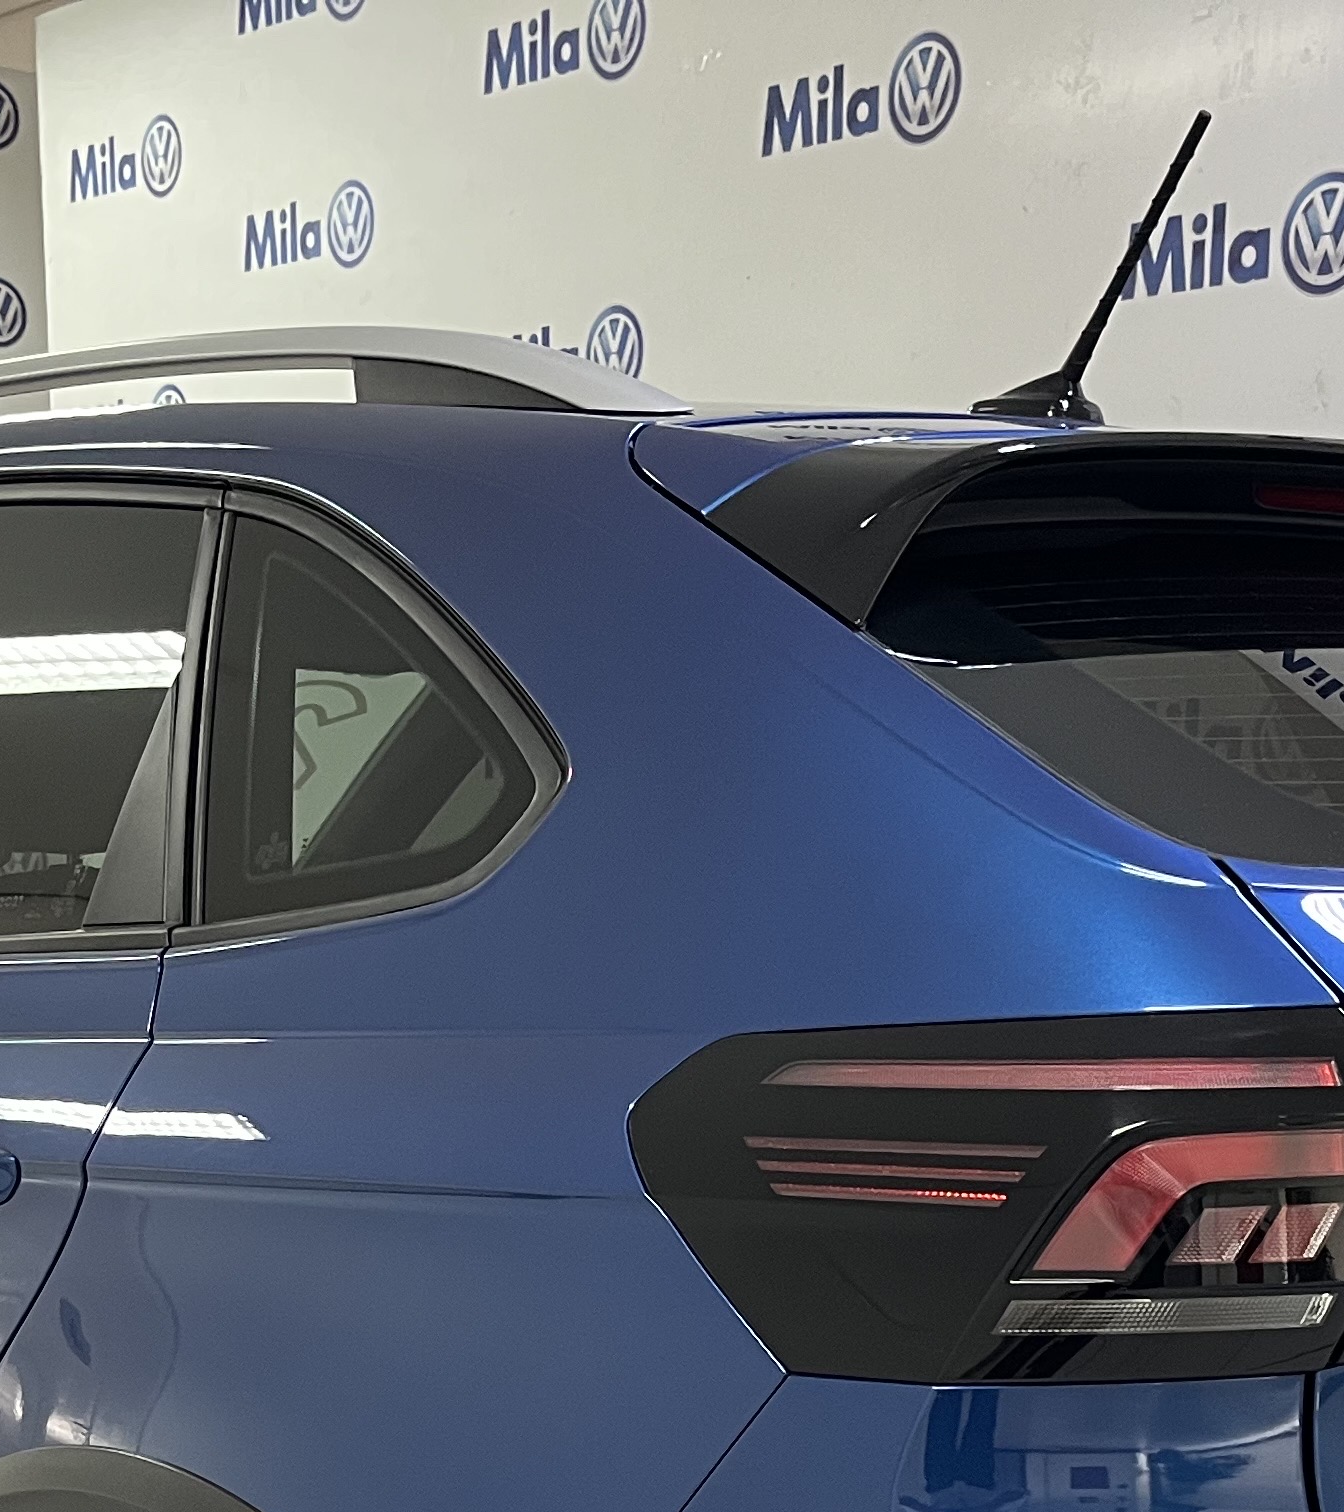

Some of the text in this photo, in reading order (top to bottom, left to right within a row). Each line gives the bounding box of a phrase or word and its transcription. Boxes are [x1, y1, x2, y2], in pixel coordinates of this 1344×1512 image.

[484, 27, 580, 95] Mila
[762, 64, 879, 157] Mila
[71, 135, 136, 202] Mila
[244, 201, 321, 272] Mila
[1119, 204, 1270, 301] Mila
